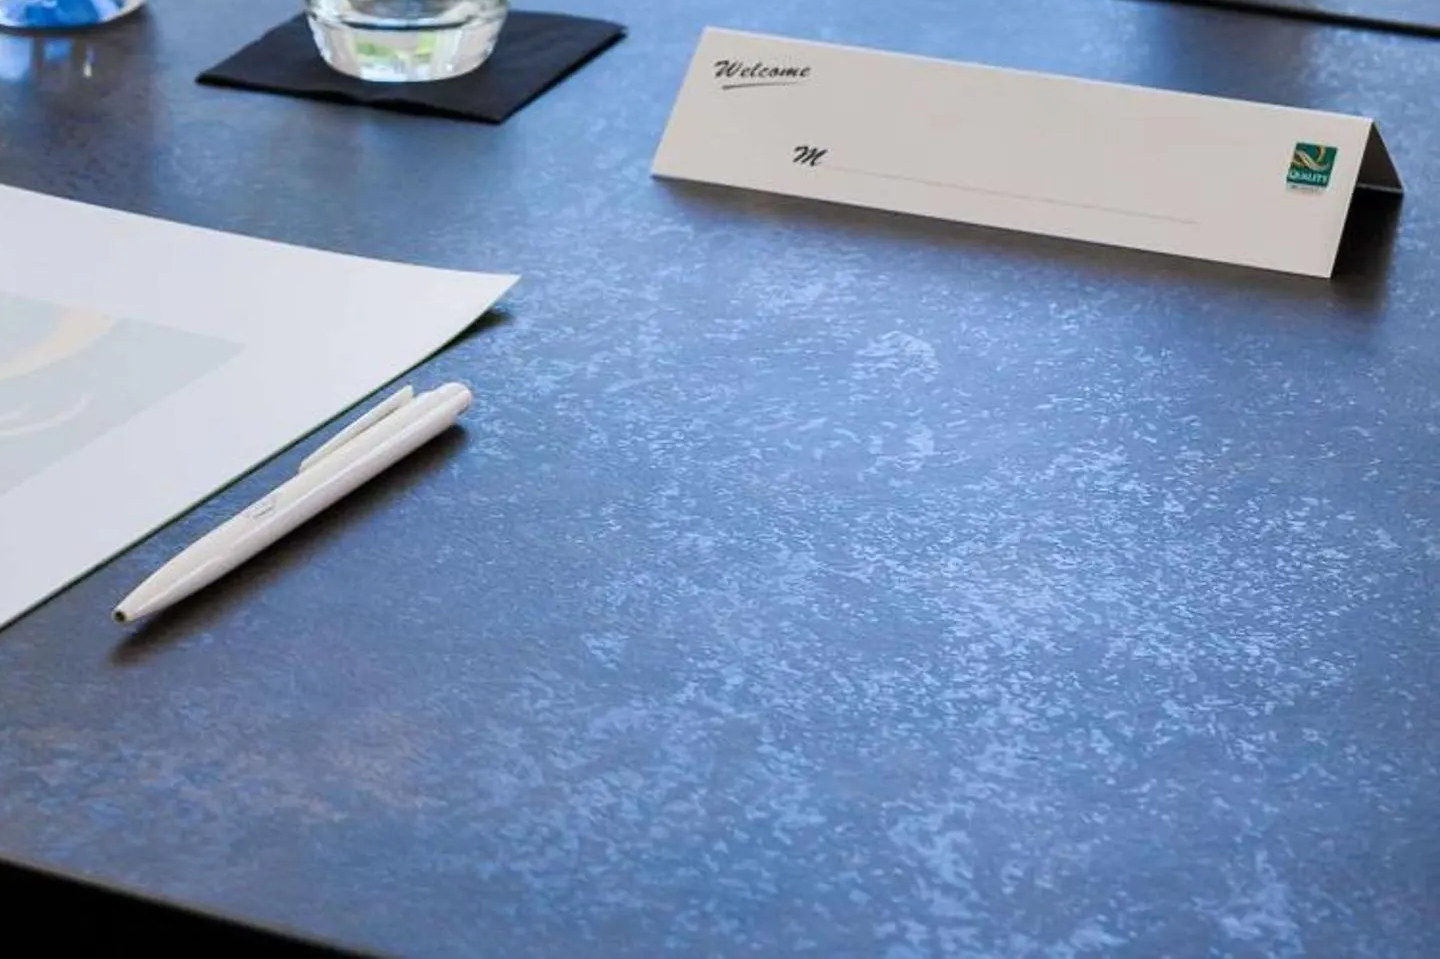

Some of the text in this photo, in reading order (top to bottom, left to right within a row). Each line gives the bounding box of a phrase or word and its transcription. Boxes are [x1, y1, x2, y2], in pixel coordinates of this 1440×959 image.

[714, 59, 812, 79] Welcome
[792, 145, 828, 167] M
[1289, 170, 1328, 184] QUALITY
